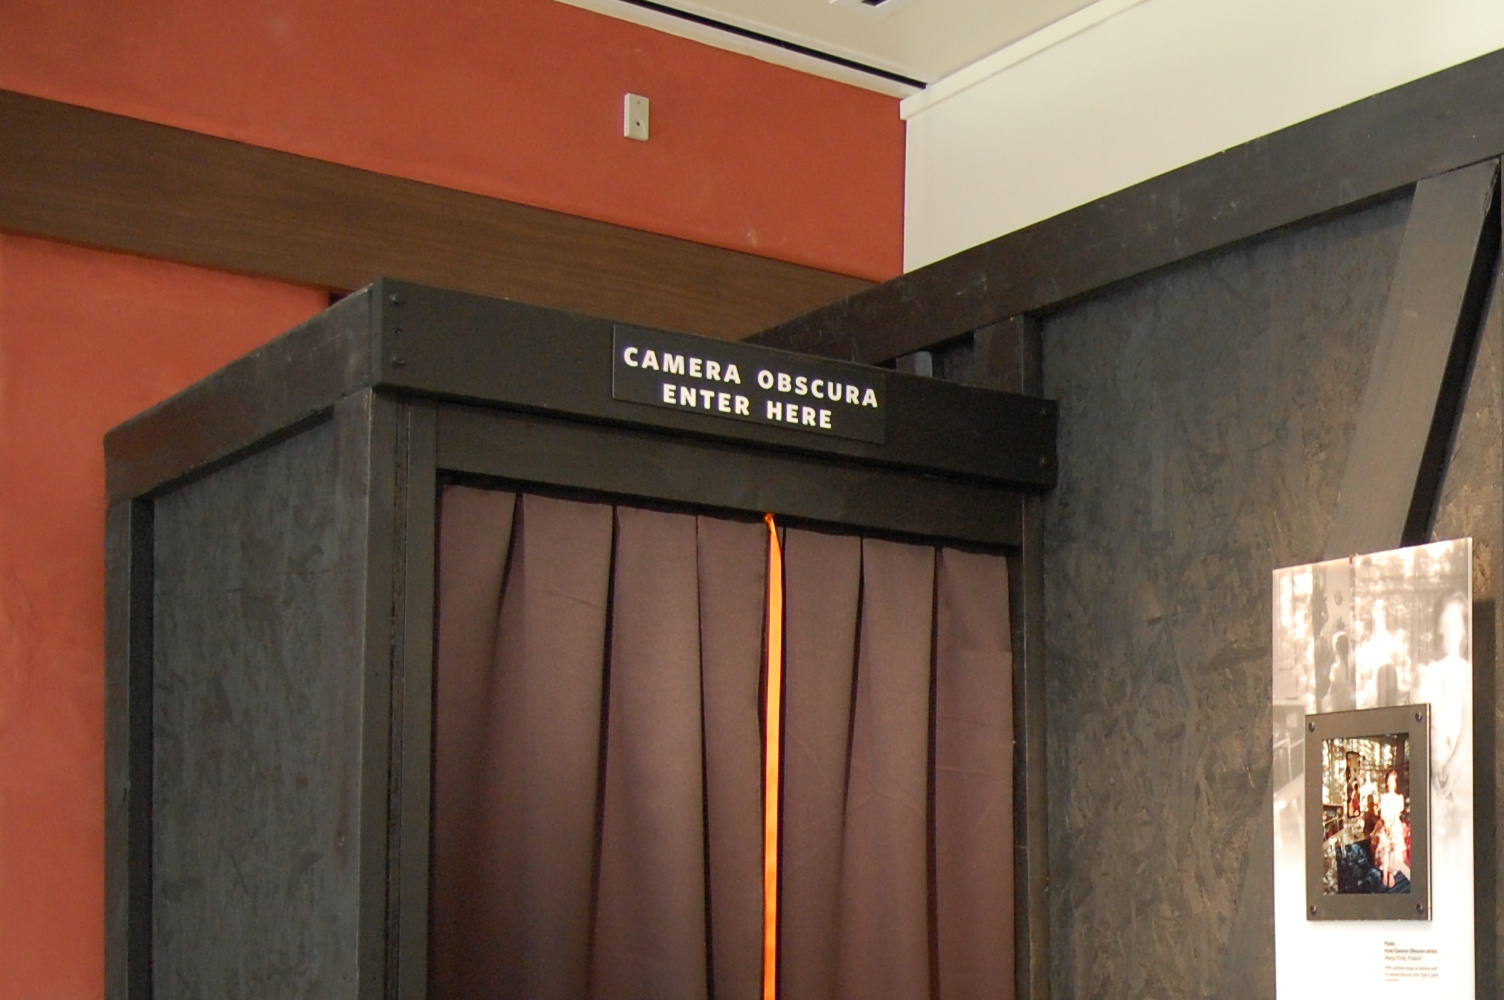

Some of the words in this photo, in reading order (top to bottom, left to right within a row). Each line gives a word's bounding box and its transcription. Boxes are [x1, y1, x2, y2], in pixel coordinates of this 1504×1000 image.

[623, 346, 742, 385] CAMERA
[757, 369, 878, 408] OBSCURA
[662, 383, 750, 416] ENTER
[766, 400, 833, 429] HERE
